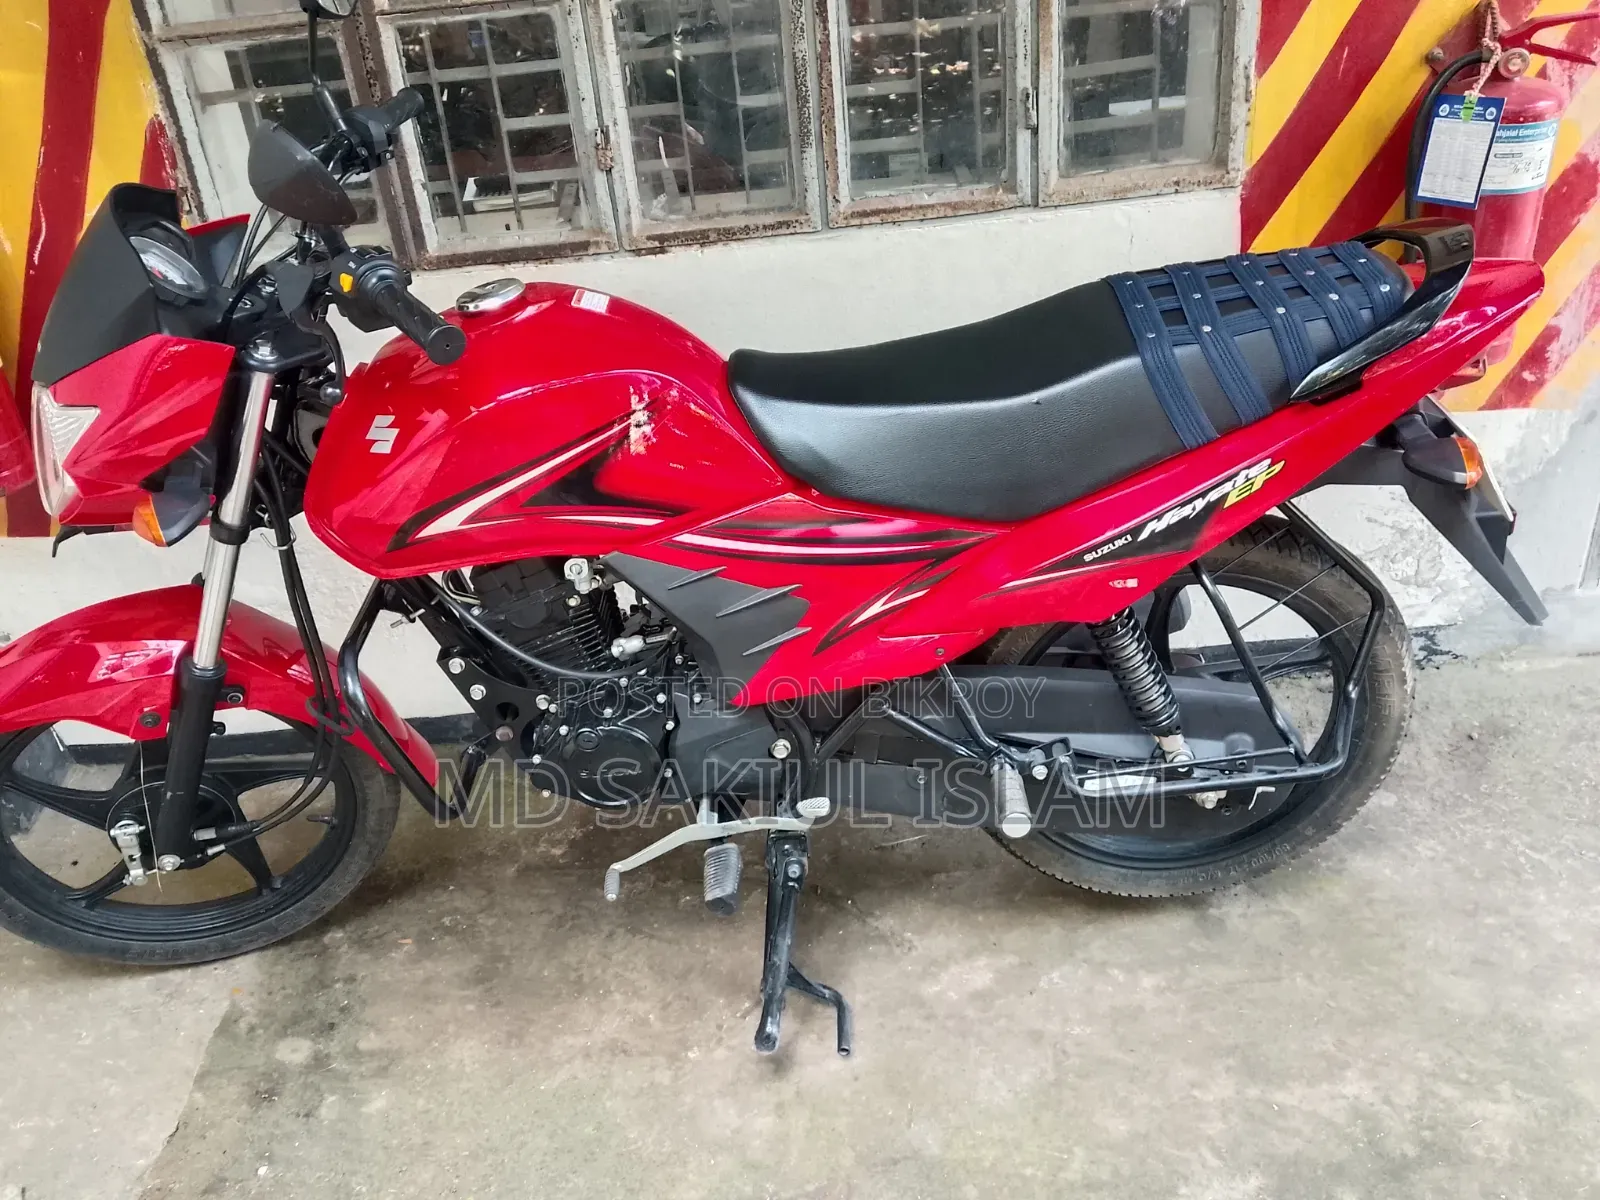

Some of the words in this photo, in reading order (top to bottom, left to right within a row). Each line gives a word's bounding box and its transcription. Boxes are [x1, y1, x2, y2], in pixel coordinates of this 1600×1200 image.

[1083, 534, 1132, 562] SUZUKI
[1137, 458, 1272, 541] Hayate
[1222, 460, 1285, 509] EP
